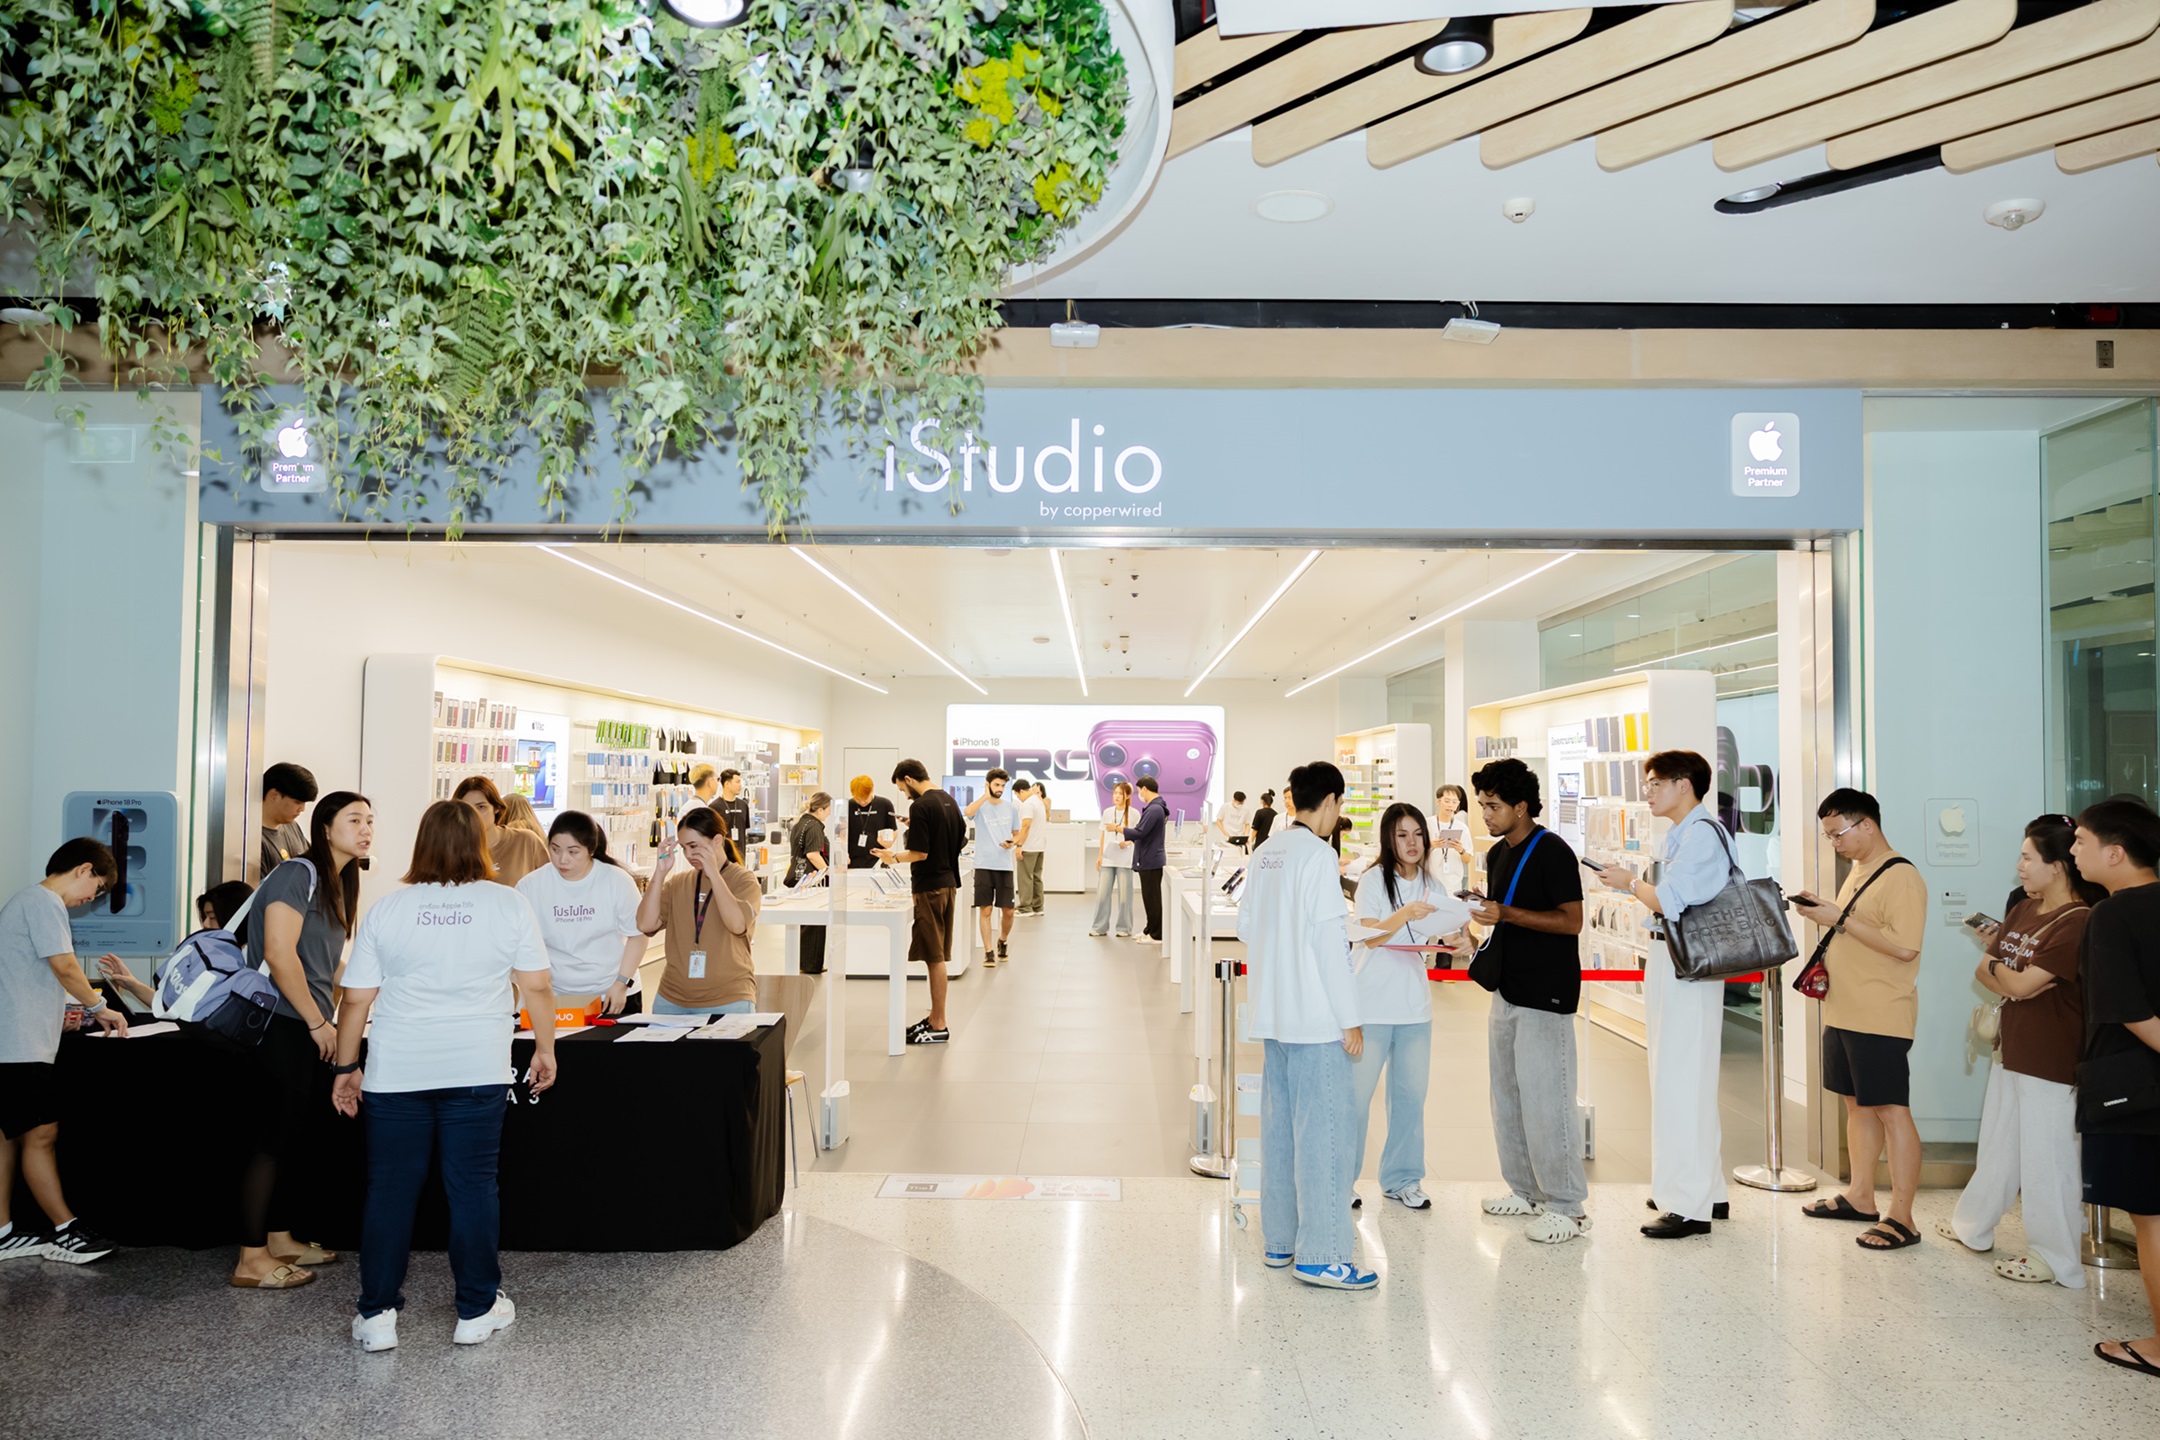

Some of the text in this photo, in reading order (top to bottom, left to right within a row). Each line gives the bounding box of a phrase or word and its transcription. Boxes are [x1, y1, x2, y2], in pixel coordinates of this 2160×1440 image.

[884, 417, 1163, 494] iStudio
[273, 463, 314, 471] Premm
[1744, 467, 1788, 475] Premium
[276, 474, 310, 482] Partner
[1748, 478, 1784, 487] Partner
[1040, 501, 1162, 520] by copperwired
[959, 738, 1000, 747] iPhone 18
[953, 749, 1094, 780] PRO
[1260, 857, 1283, 869] Studio
[441, 902, 462, 910] Apple
[553, 905, 596, 917] โปรไปไกล
[417, 911, 473, 926] iStudio
[1708, 906, 1746, 923] THE
[1685, 923, 1734, 942] TOTE
